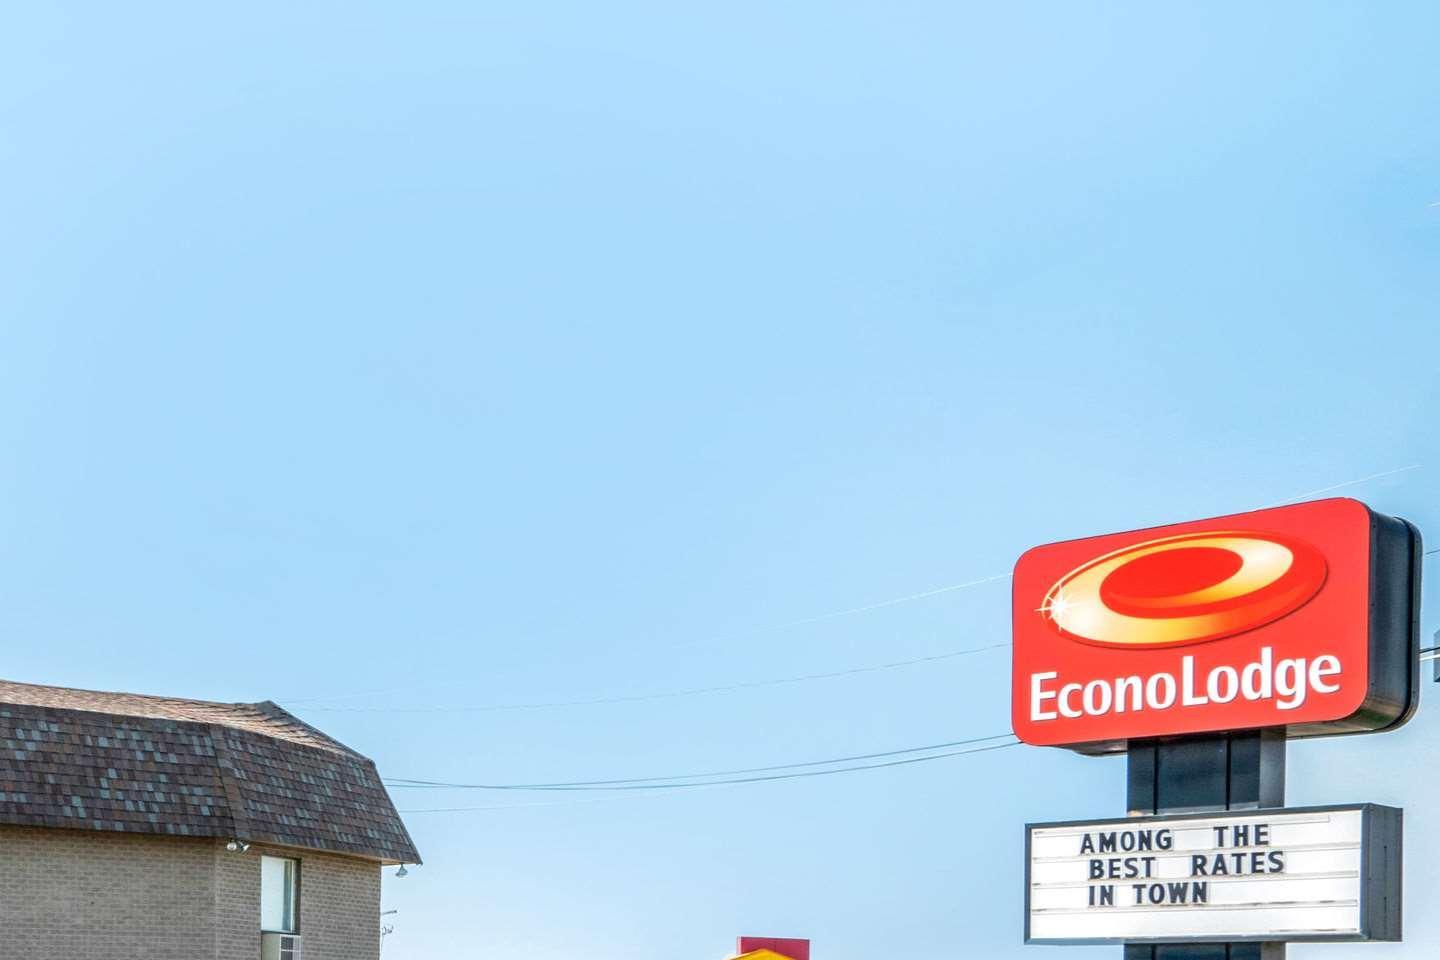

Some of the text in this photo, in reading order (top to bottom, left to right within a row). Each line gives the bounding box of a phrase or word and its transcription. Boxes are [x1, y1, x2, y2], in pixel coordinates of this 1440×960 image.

[1080, 824, 1269, 854] AMONG THE
[1089, 850, 1285, 880] BEST RATES
[1088, 881, 1208, 906] IN TOWN
